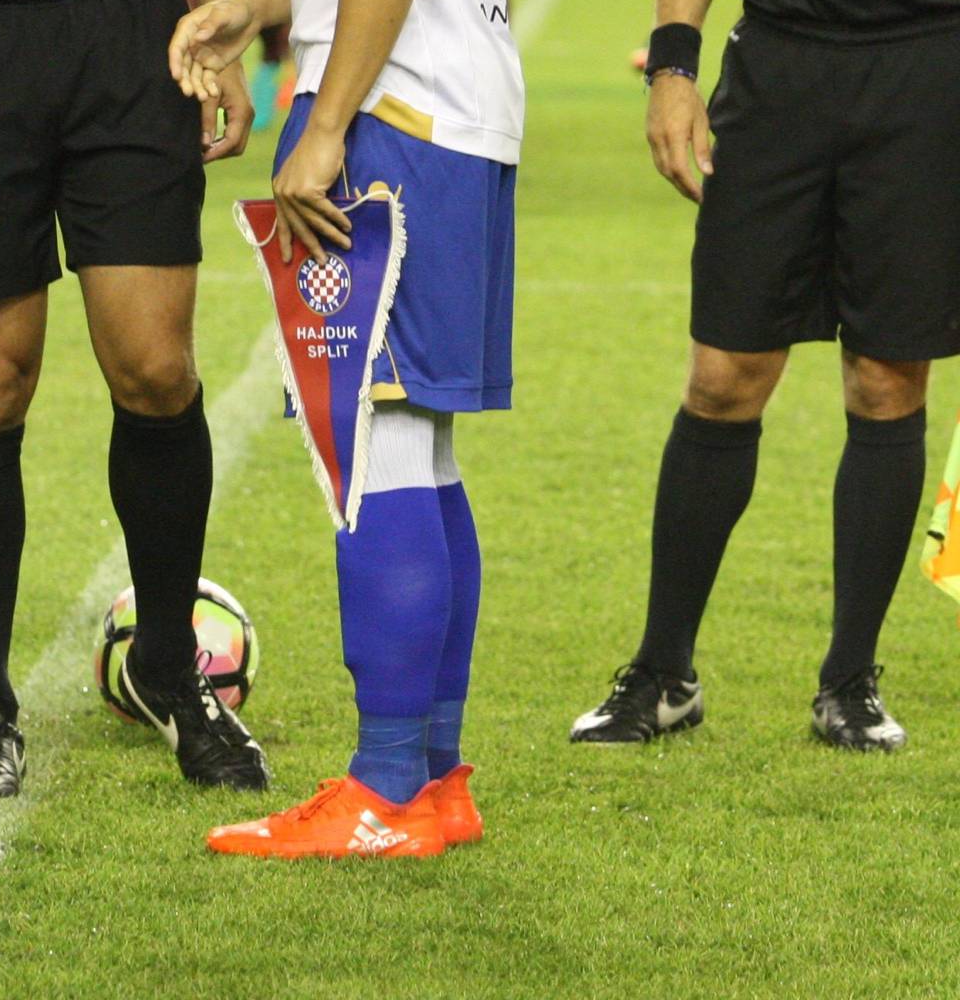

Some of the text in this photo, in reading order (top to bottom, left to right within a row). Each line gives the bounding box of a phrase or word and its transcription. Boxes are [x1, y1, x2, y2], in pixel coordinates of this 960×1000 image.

[301, 257, 344, 275] HAUK
[309, 298, 340, 313] SPLIT
[296, 326, 359, 340] HAJDUK
[307, 344, 350, 358] SPLIT
